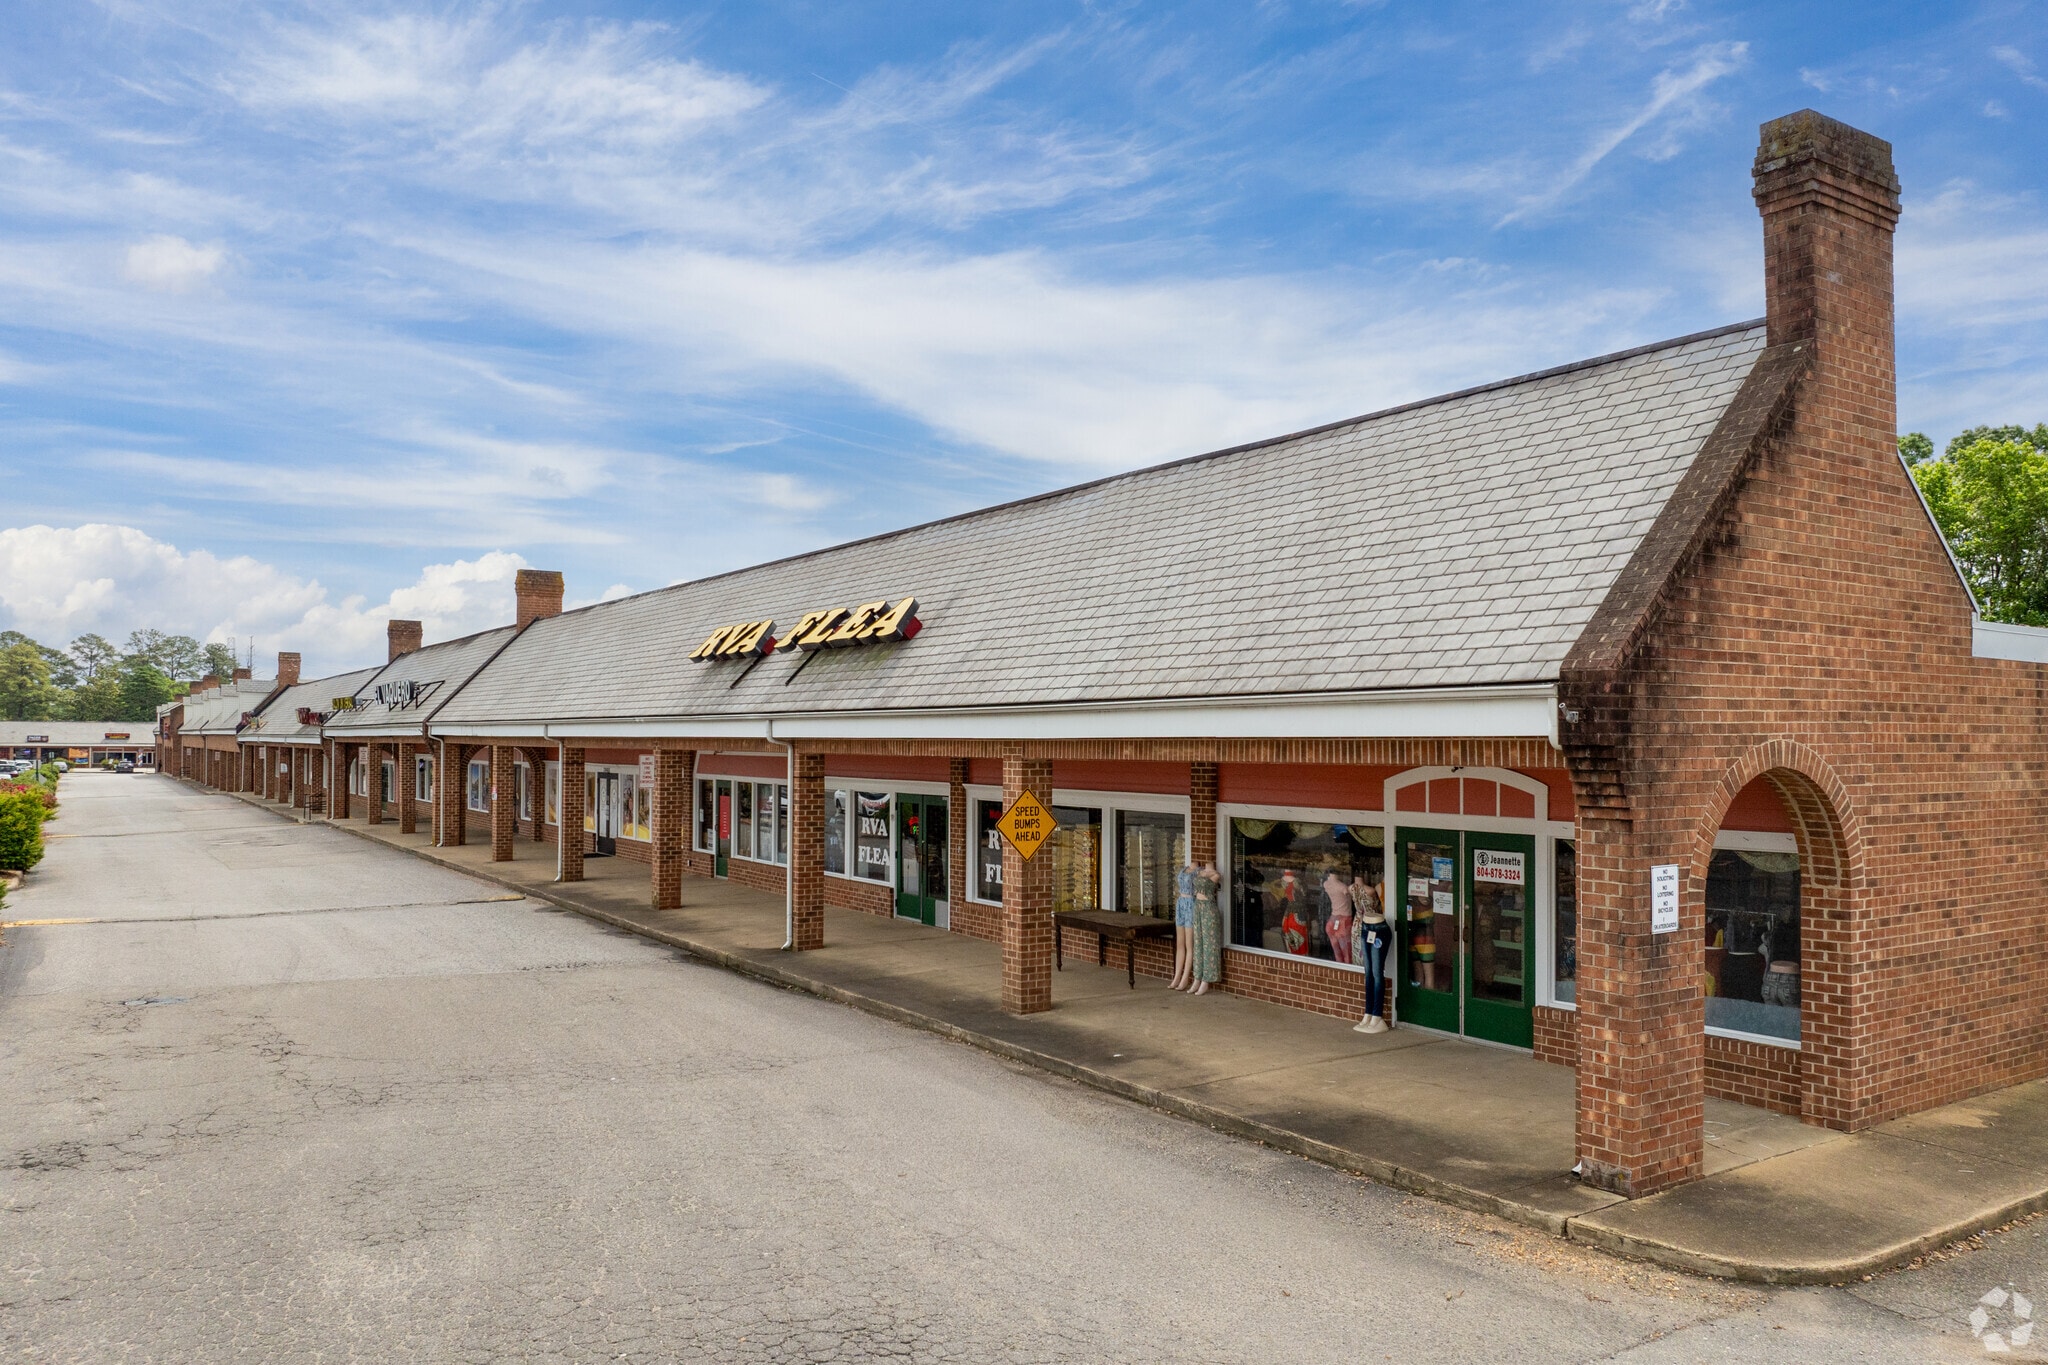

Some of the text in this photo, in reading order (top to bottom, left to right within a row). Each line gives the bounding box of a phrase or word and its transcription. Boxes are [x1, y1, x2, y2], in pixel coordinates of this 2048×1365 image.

[690, 597, 916, 660] RVA FLEA
[381, 680, 411, 704] VAQUERO
[1015, 806, 1040, 817] SPEED
[861, 817, 888, 837] RVA
[1014, 818, 1041, 830] BUMPS
[1015, 831, 1041, 842] AHEAD
[858, 845, 890, 866] FLEA
[1490, 855, 1521, 866] Jeannette
[1476, 866, 1521, 881] 804-878-3324
[1657, 906, 1674, 914] BICYCLES
